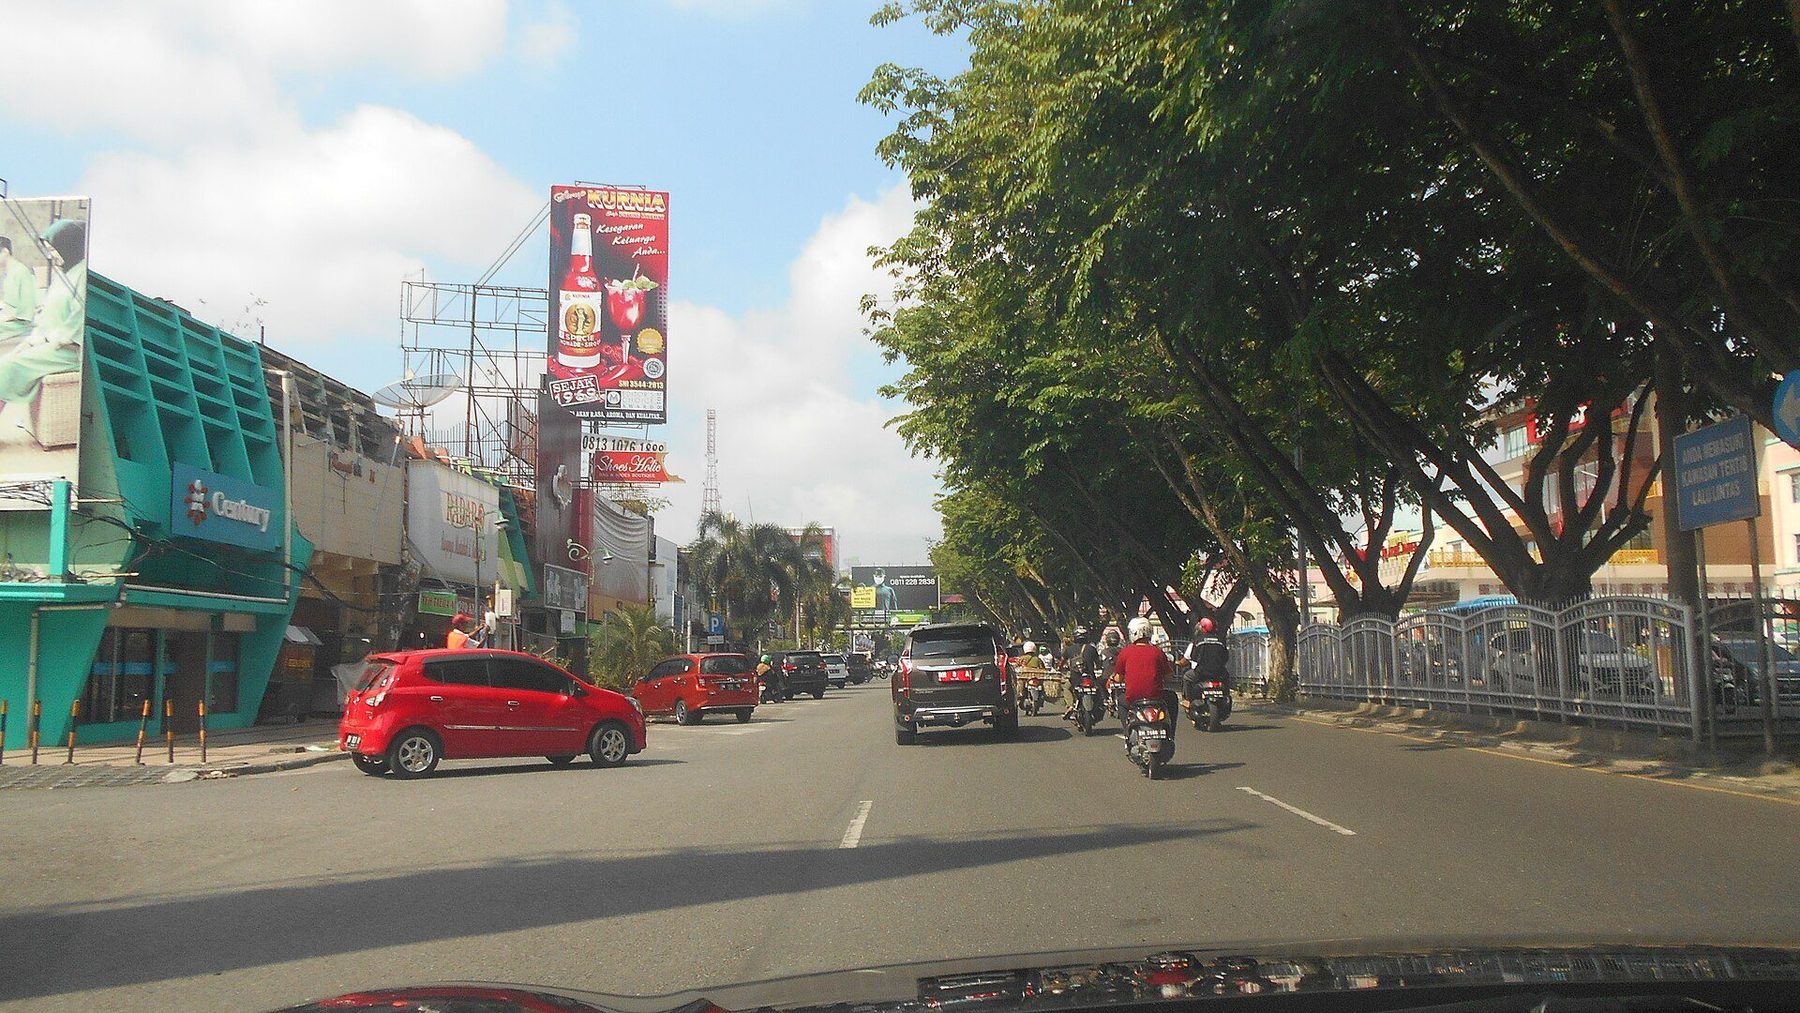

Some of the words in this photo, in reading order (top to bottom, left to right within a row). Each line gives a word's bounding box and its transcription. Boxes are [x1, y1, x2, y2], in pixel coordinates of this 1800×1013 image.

[587, 190, 666, 213] KURNIA
[596, 223, 644, 234] Kesegaran
[612, 235, 656, 246] Keluarga
[552, 378, 596, 393] SEJAK
[606, 411, 625, 419] AROMA,
[582, 435, 607, 451] 0813
[596, 455, 628, 472] Shoes
[212, 491, 271, 533] Century
[711, 617, 719, 632] P
